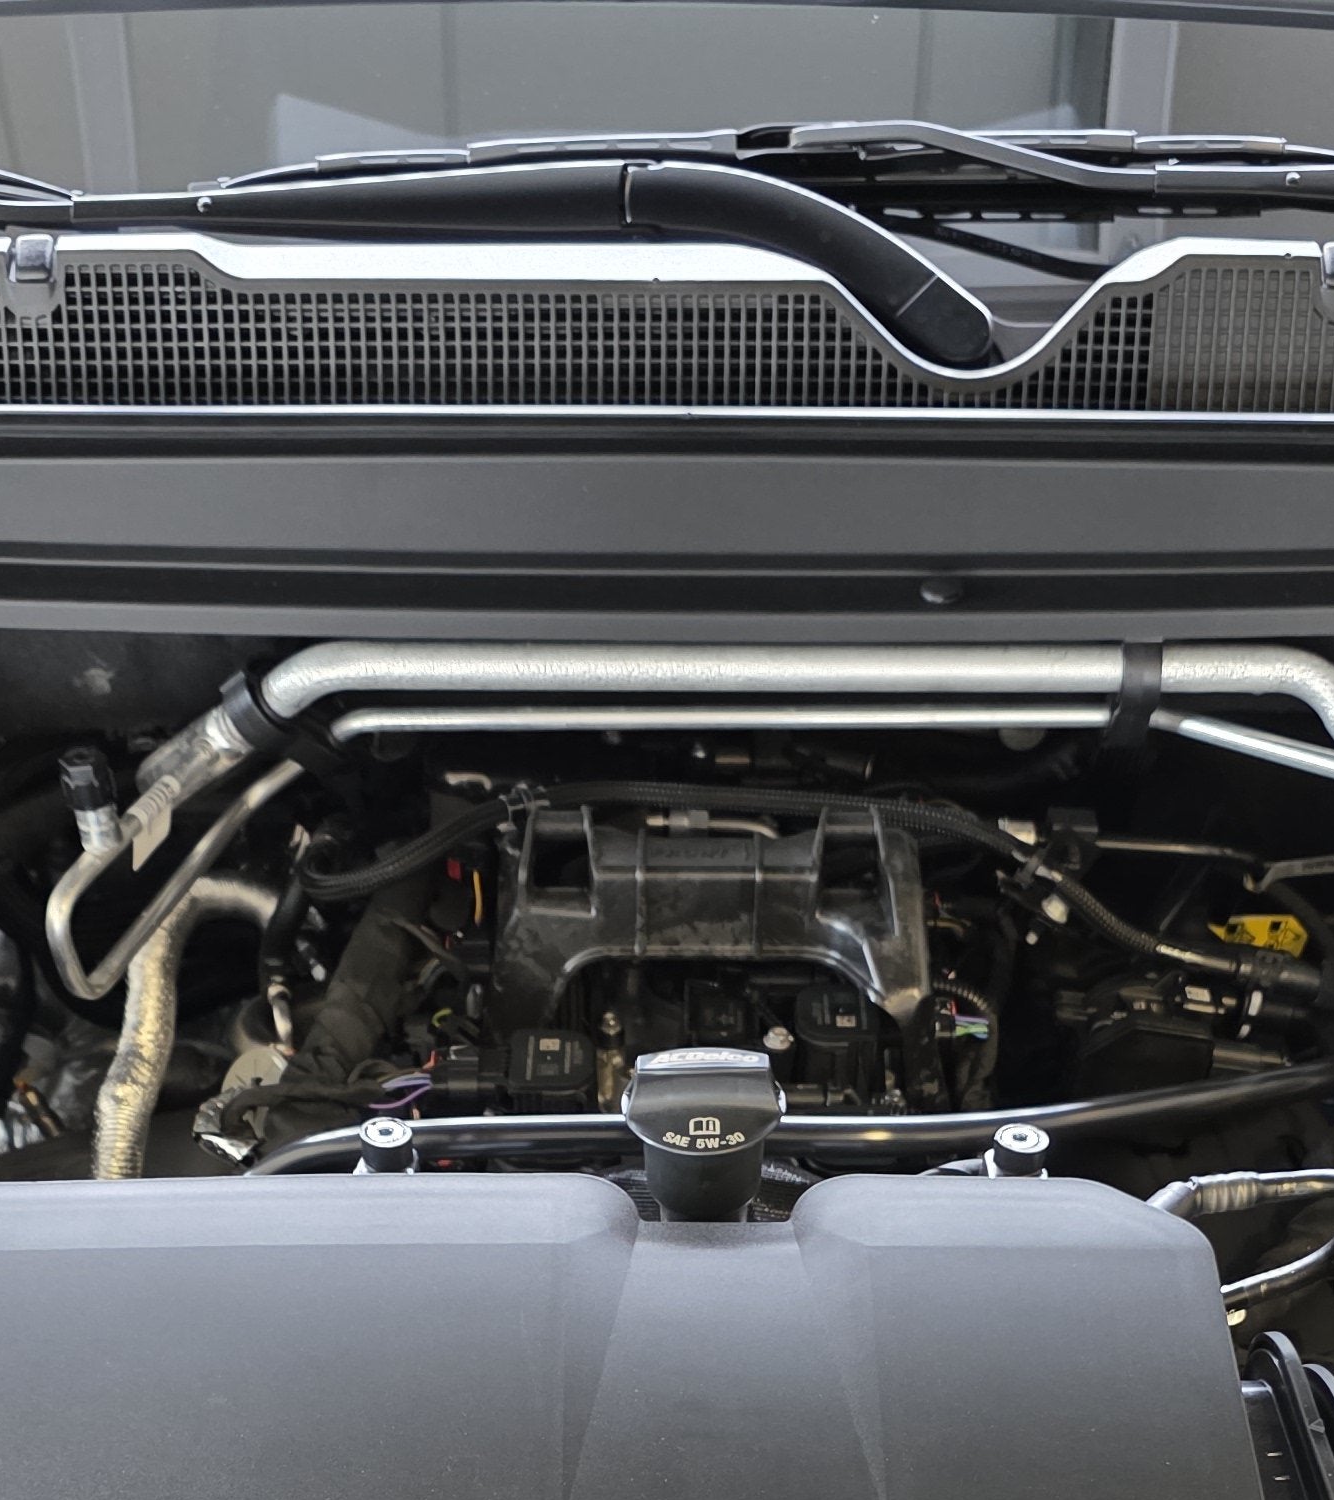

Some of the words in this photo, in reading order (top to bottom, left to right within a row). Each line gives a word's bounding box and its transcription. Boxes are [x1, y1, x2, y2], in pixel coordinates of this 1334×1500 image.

[649, 1051, 760, 1064] ACDelco
[662, 1131, 691, 1148] SAE
[695, 1131, 746, 1149] 5W-30
